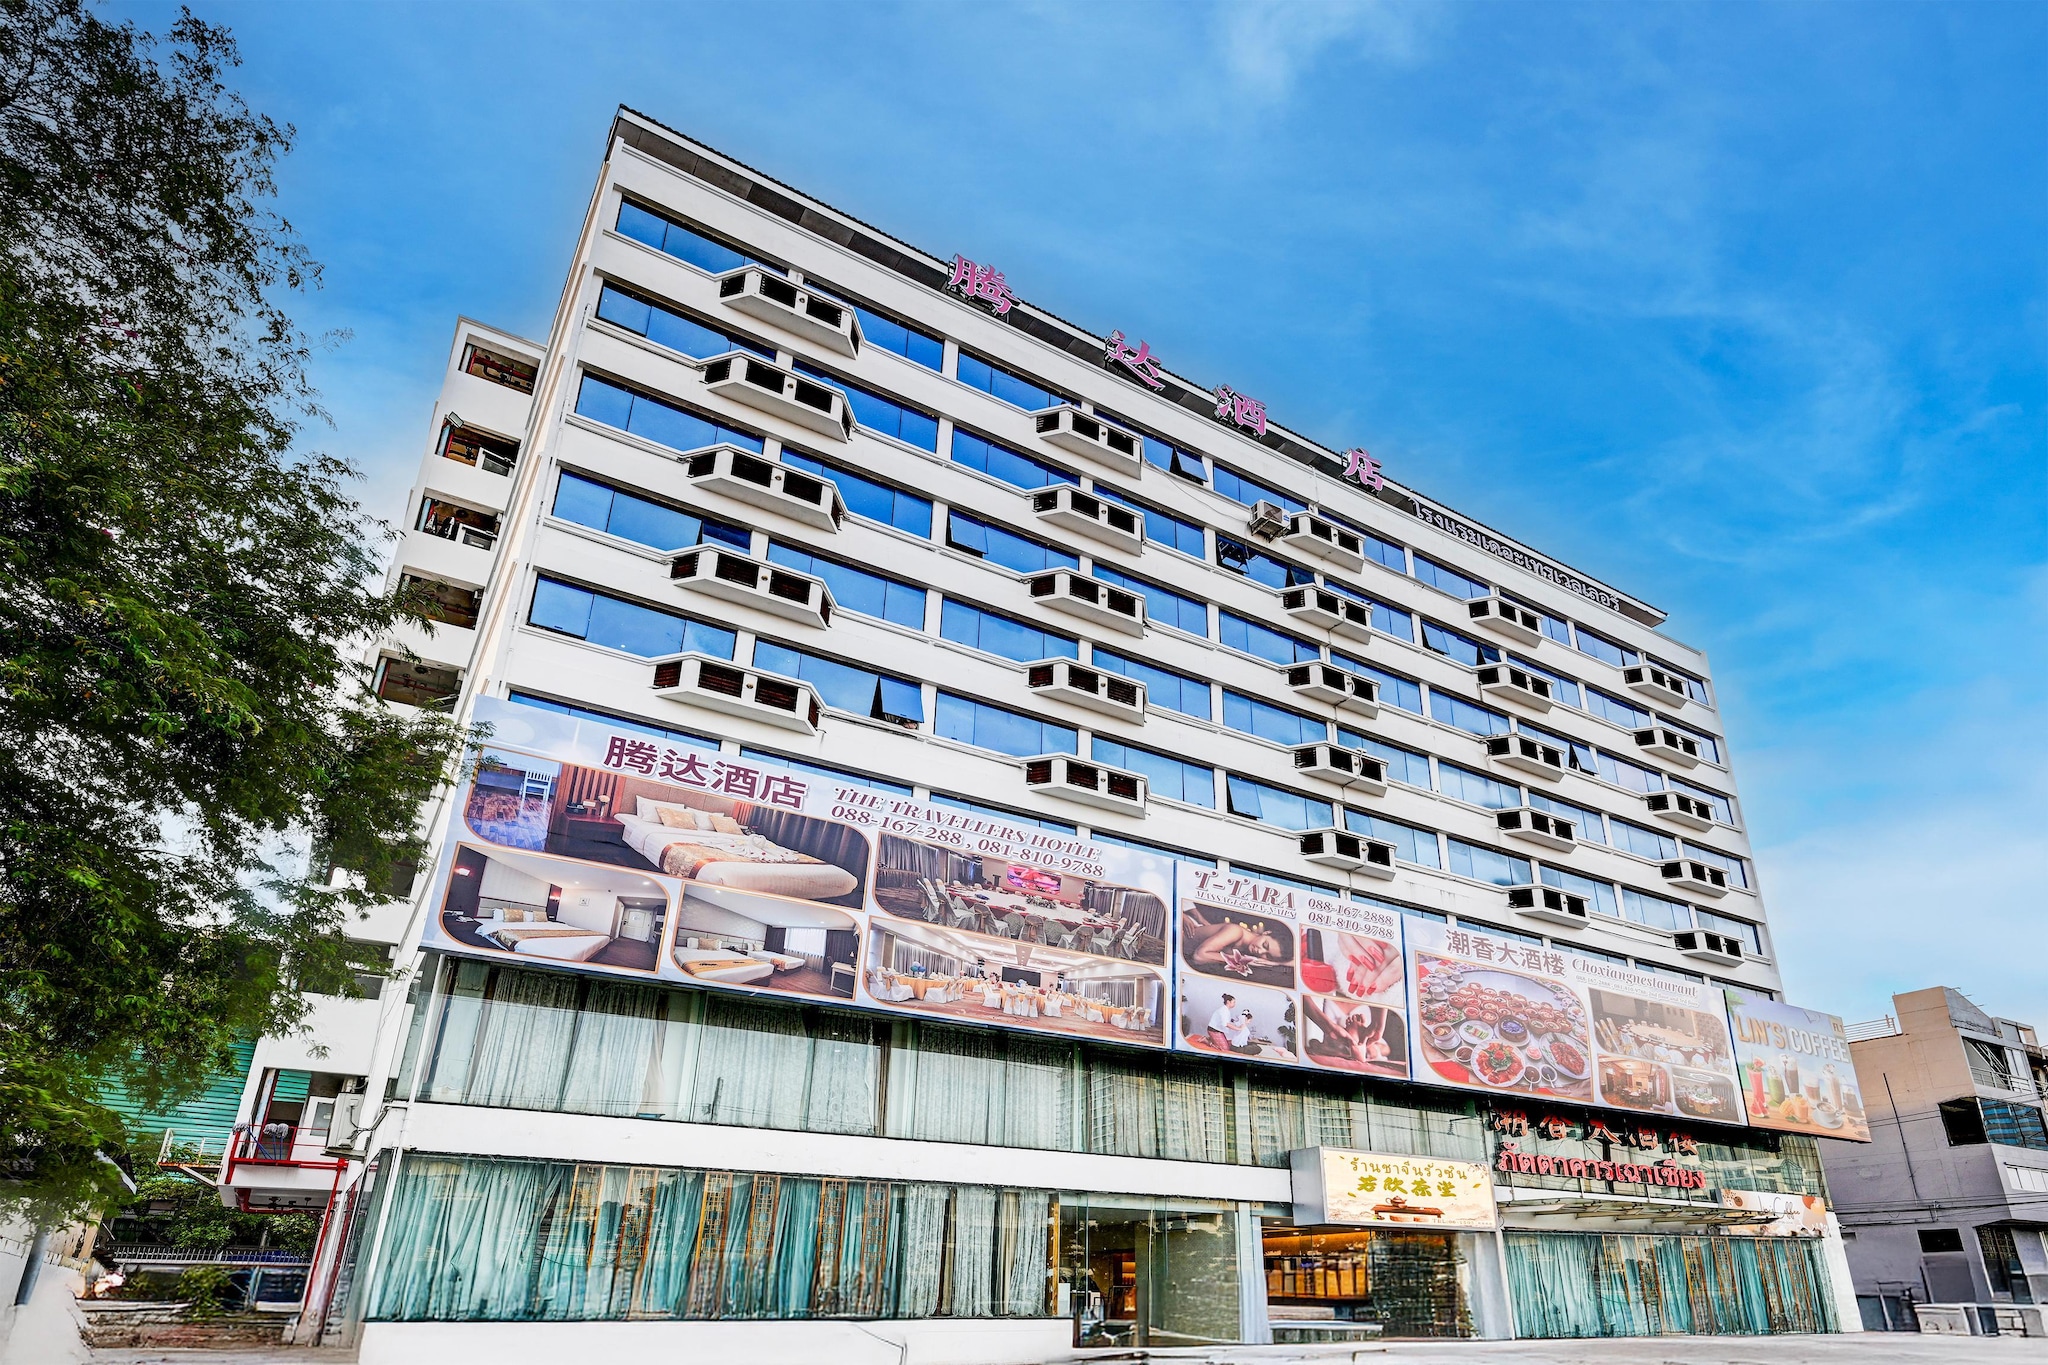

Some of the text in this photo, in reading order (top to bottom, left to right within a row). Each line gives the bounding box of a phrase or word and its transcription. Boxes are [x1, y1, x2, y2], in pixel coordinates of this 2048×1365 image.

[603, 735, 808, 810] 腾达酒店
[834, 787, 884, 810] THE
[890, 801, 1028, 843] TRAVELLERS
[977, 838, 1104, 877] 081-810-9788
[1195, 871, 1295, 909] T-TARA
[1308, 898, 1394, 926] 088-167-2888
[1308, 912, 1394, 939] 081-810-9788
[1445, 928, 1565, 977] 潮香大酒楼
[1734, 1014, 1850, 1064] LIN'S COFFEE
